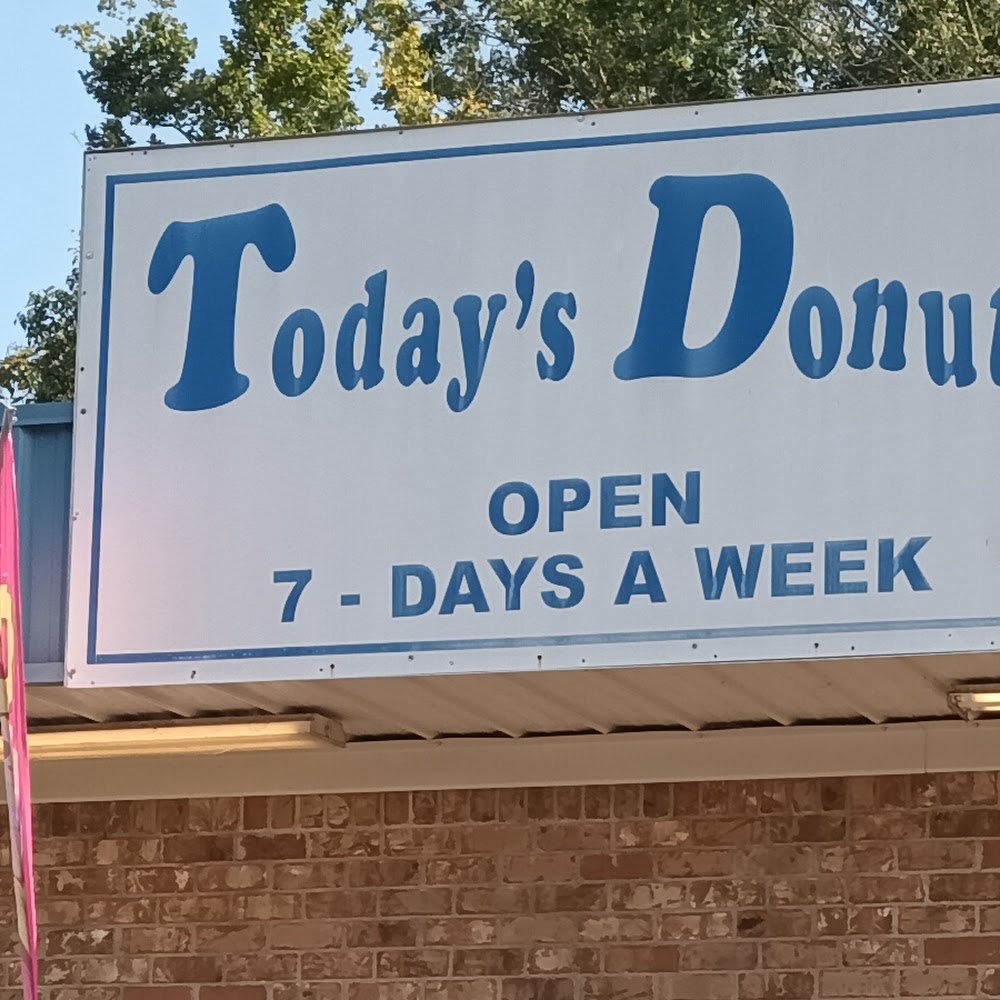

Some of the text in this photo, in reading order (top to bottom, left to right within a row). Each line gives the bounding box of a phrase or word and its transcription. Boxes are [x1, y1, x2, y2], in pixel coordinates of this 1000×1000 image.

[148, 203, 578, 412] Today's
[488, 471, 701, 535] OPEN
[273, 570, 313, 622] 7
[392, 554, 586, 618] DAYS
[615, 551, 667, 605] A
[696, 537, 931, 600] WEEK
